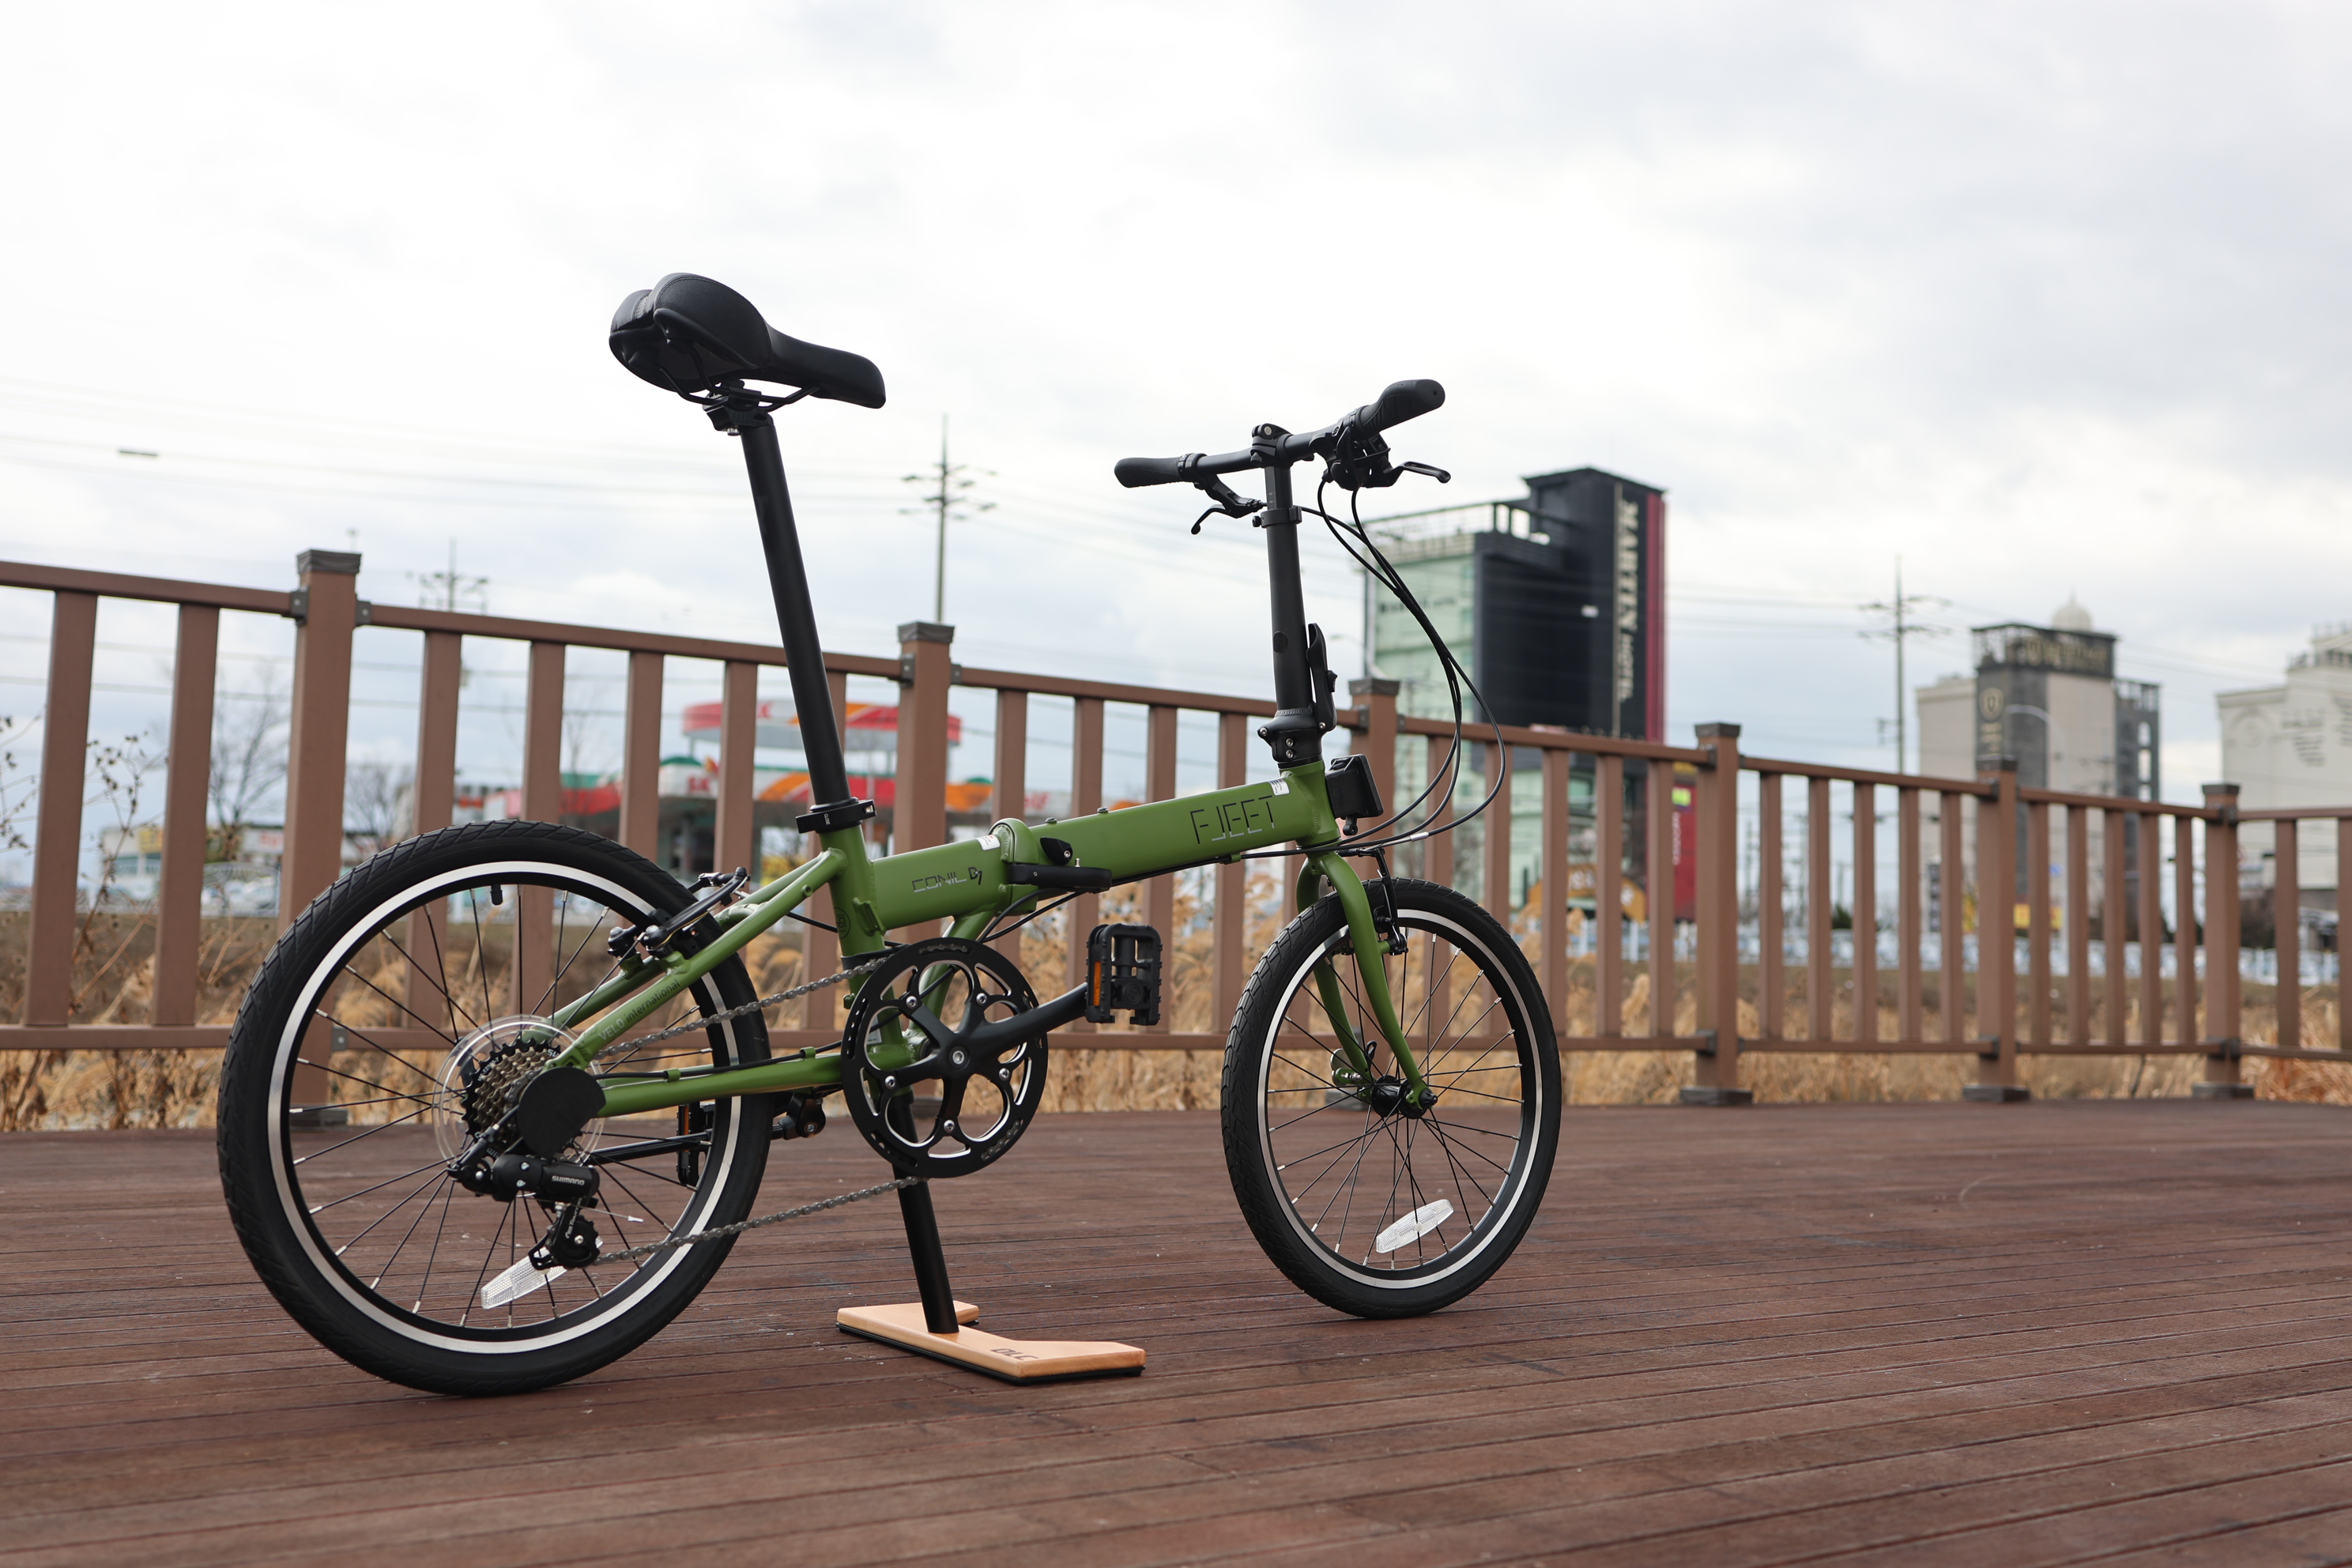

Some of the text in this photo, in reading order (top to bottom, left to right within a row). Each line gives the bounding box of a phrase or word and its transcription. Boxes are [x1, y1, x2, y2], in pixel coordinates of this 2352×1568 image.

[911, 872, 967, 892] CONIL
[598, 978, 680, 1041] VELO international
[552, 1175, 585, 1185] SHIMANO
